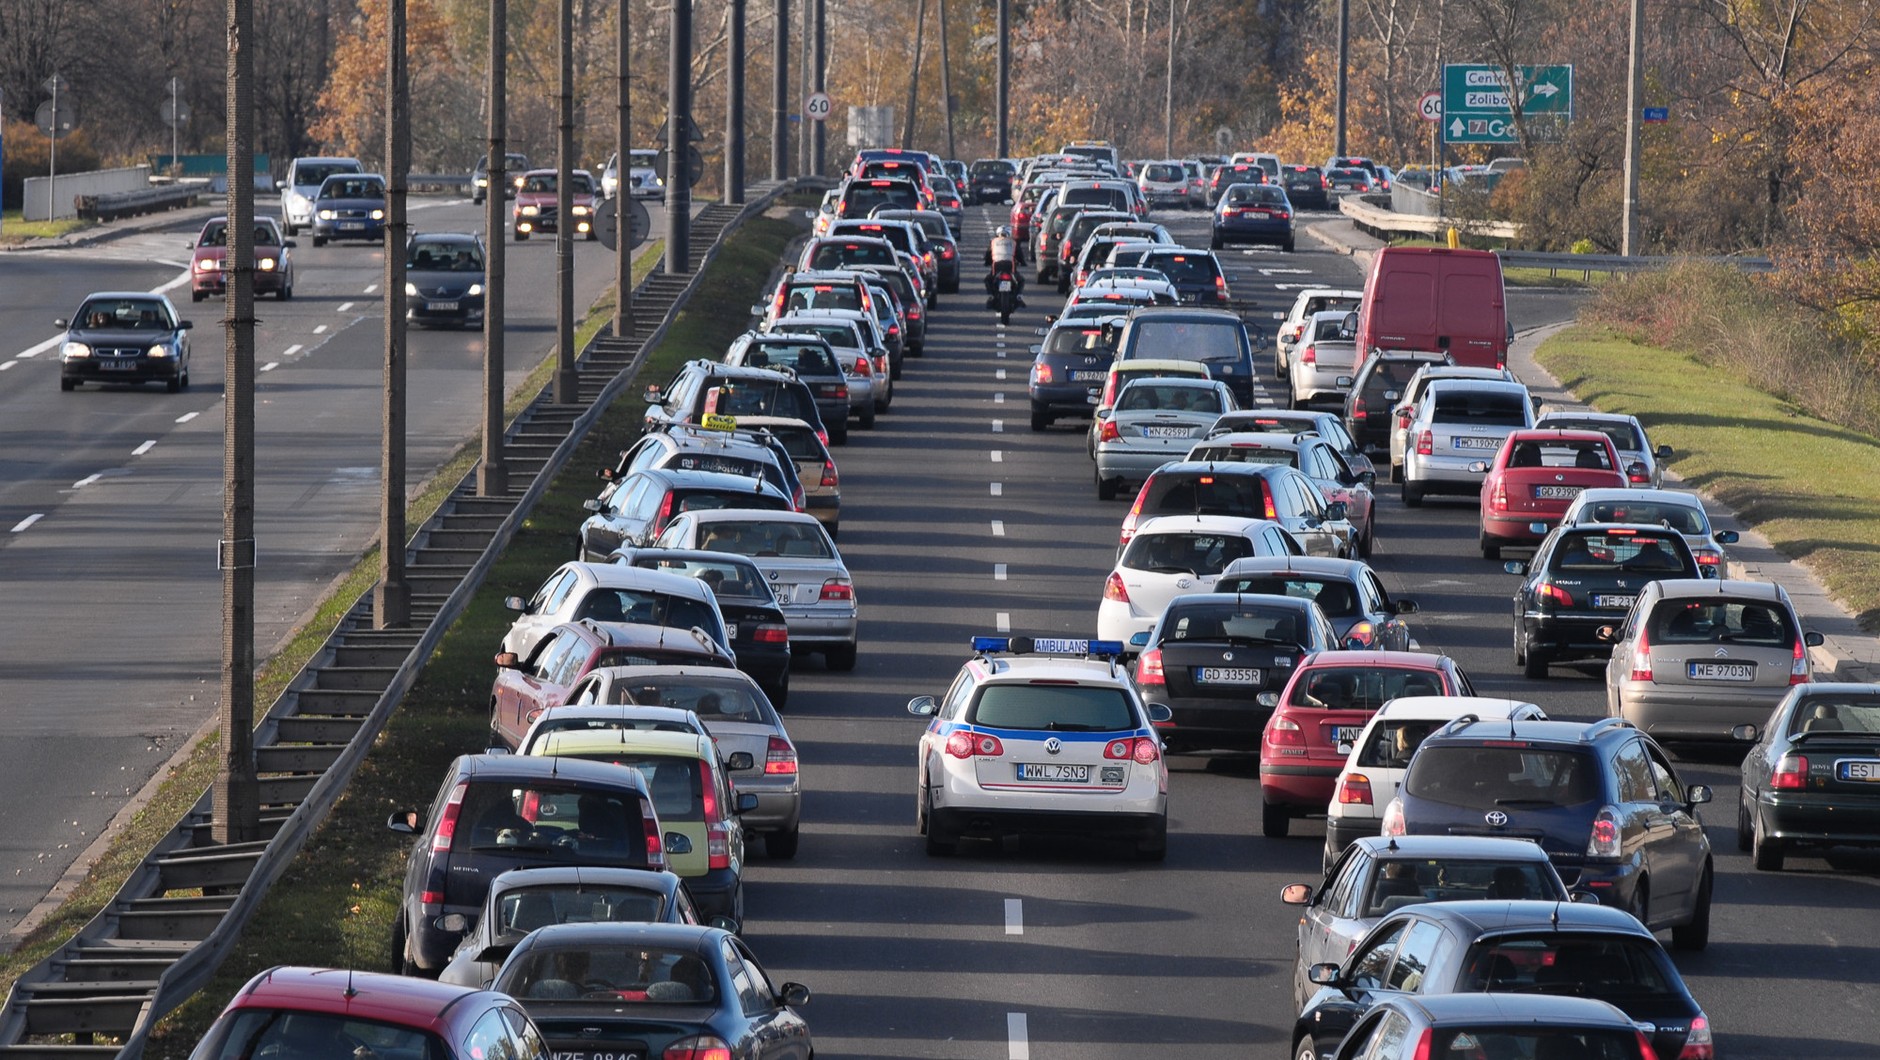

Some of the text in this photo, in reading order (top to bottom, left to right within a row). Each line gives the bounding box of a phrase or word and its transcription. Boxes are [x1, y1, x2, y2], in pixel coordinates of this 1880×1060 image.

[1469, 72, 1520, 83] Centr
[809, 99, 828, 113] 60
[1423, 99, 1440, 114] 60
[1541, 487, 1554, 497] GD
[1601, 596, 1615, 606] WE
[1035, 640, 1088, 653] AMBULANS
[1204, 669, 1259, 681] GD 3355R
[1697, 665, 1752, 677] WE 9703N
[1025, 765, 1086, 779] WWL 7SN3
